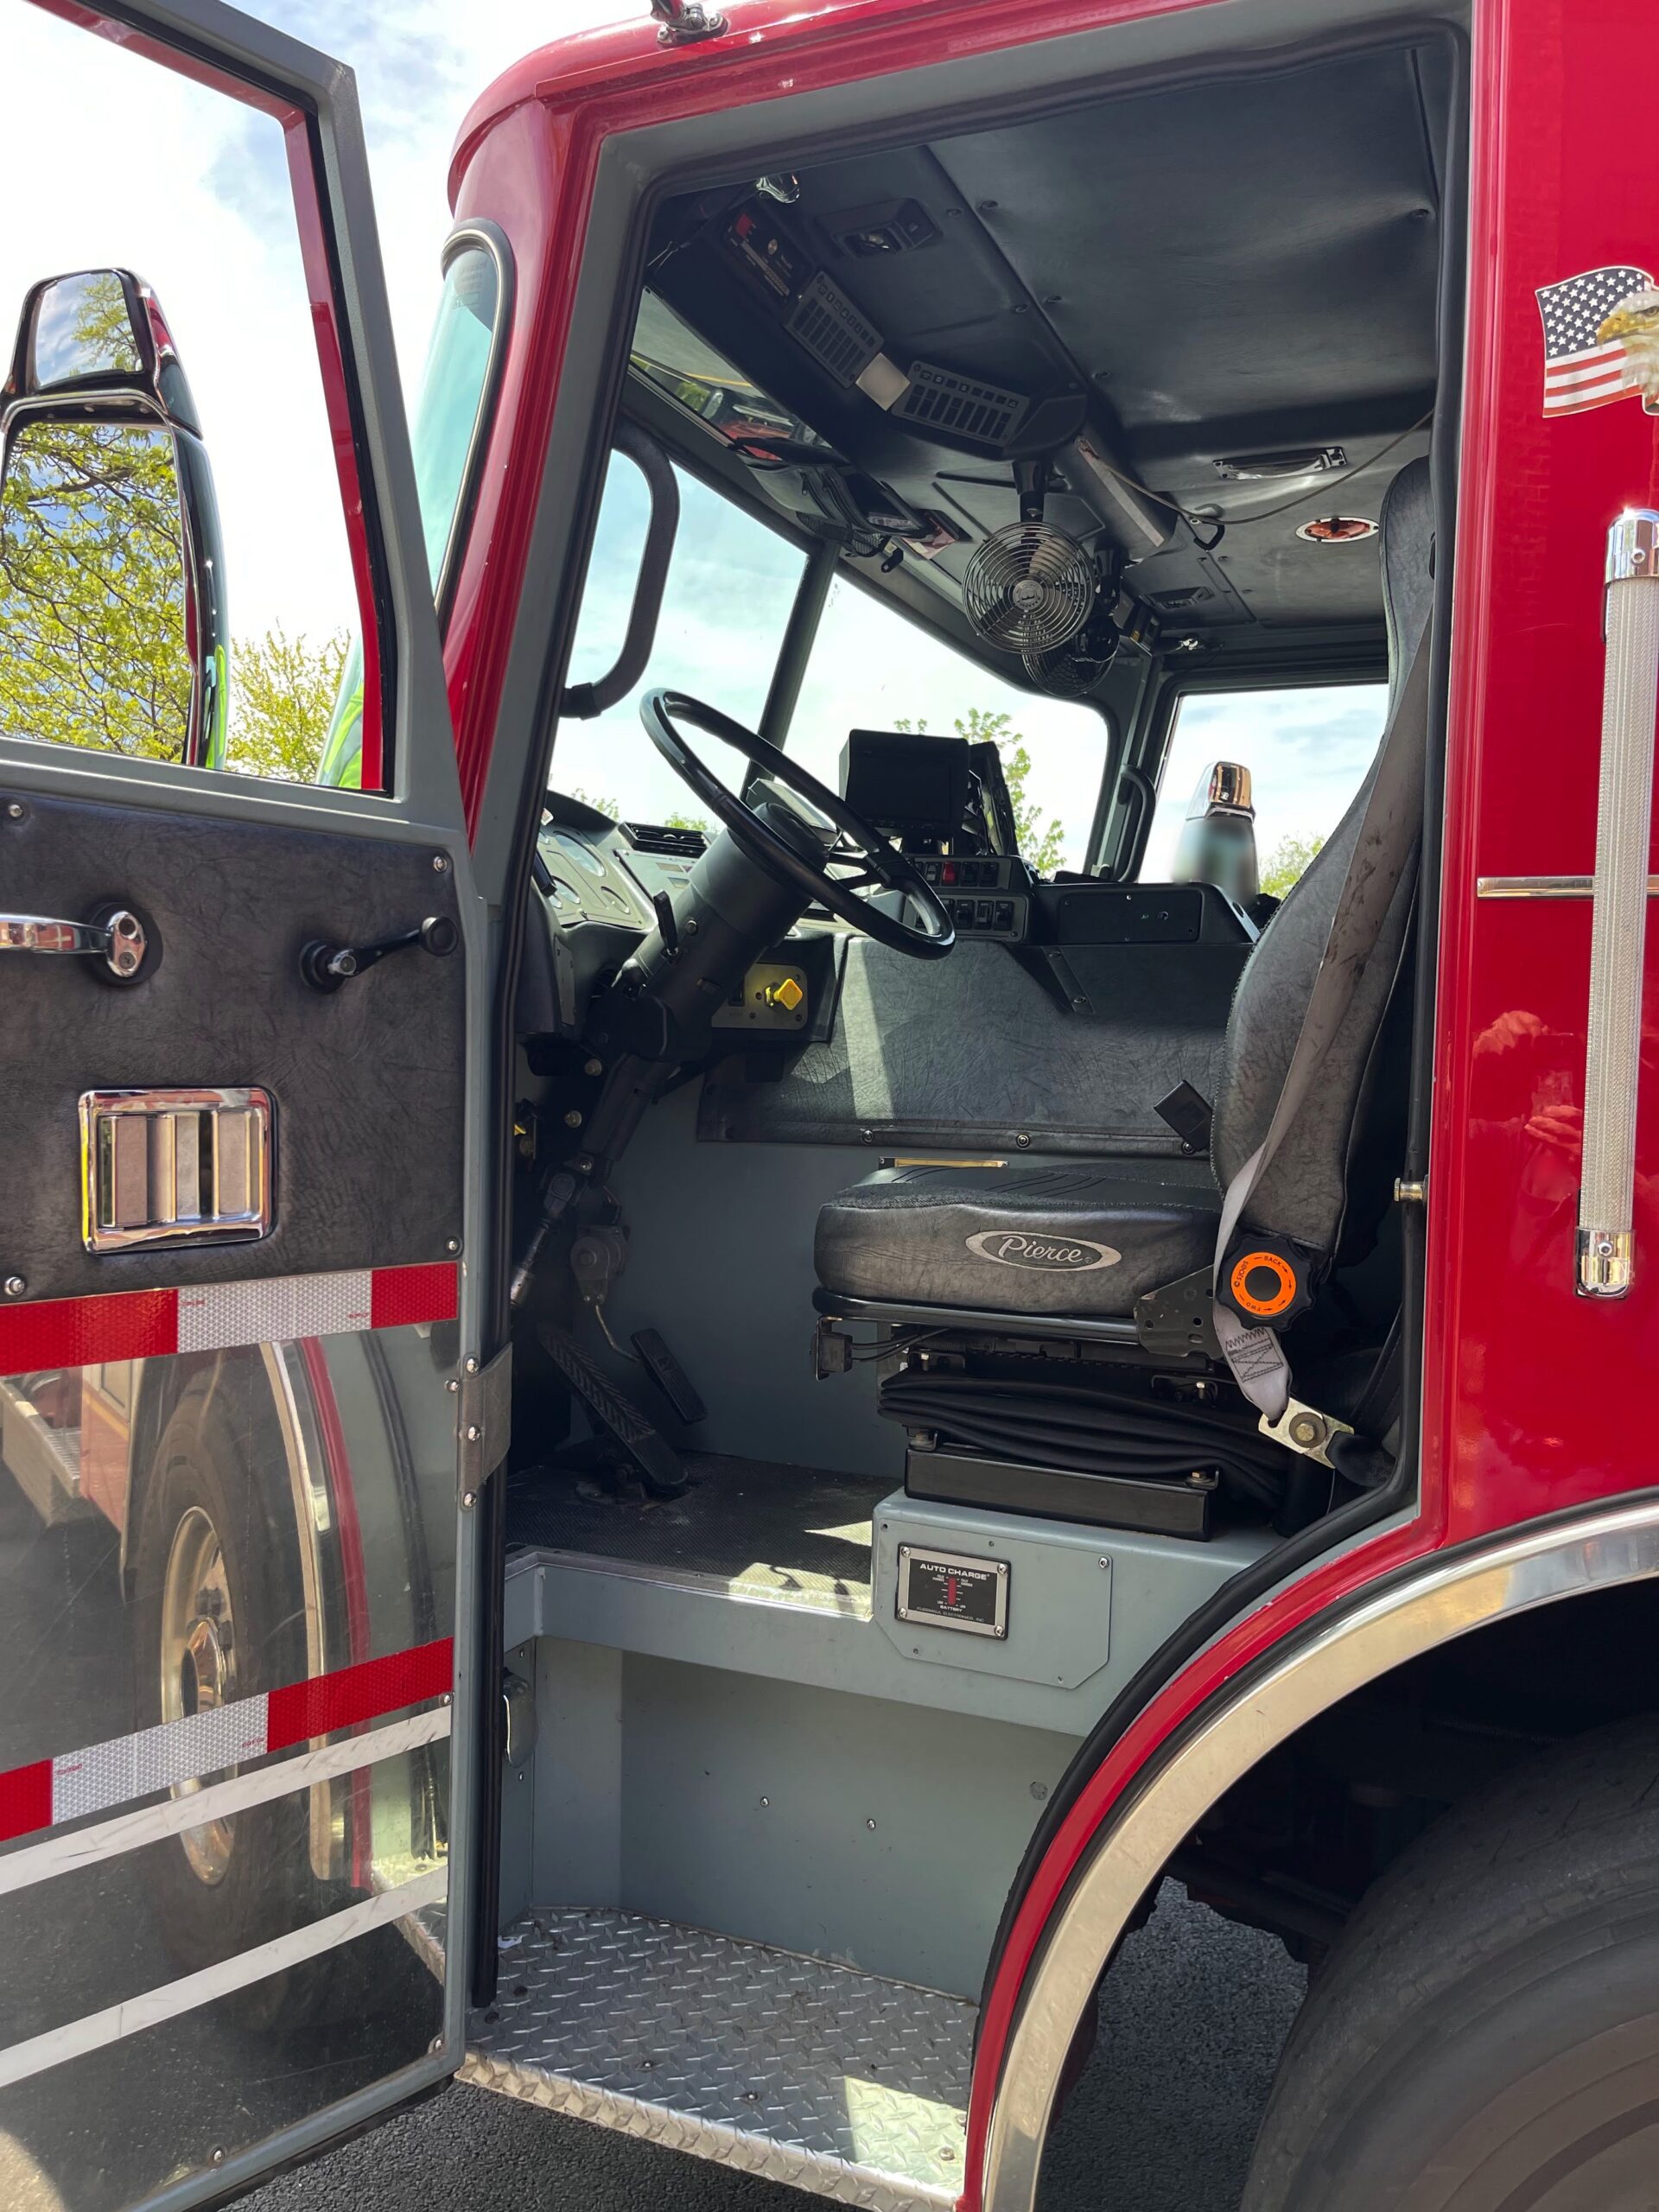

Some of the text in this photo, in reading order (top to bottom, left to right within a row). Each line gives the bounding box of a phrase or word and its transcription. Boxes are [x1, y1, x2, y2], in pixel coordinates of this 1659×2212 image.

[998, 1235, 1084, 1263] Pierce
[1263, 1255, 1282, 1267] BACK
[1247, 1302, 1262, 1312] FWD
[919, 1563, 987, 1580] AUTO CHARGE
